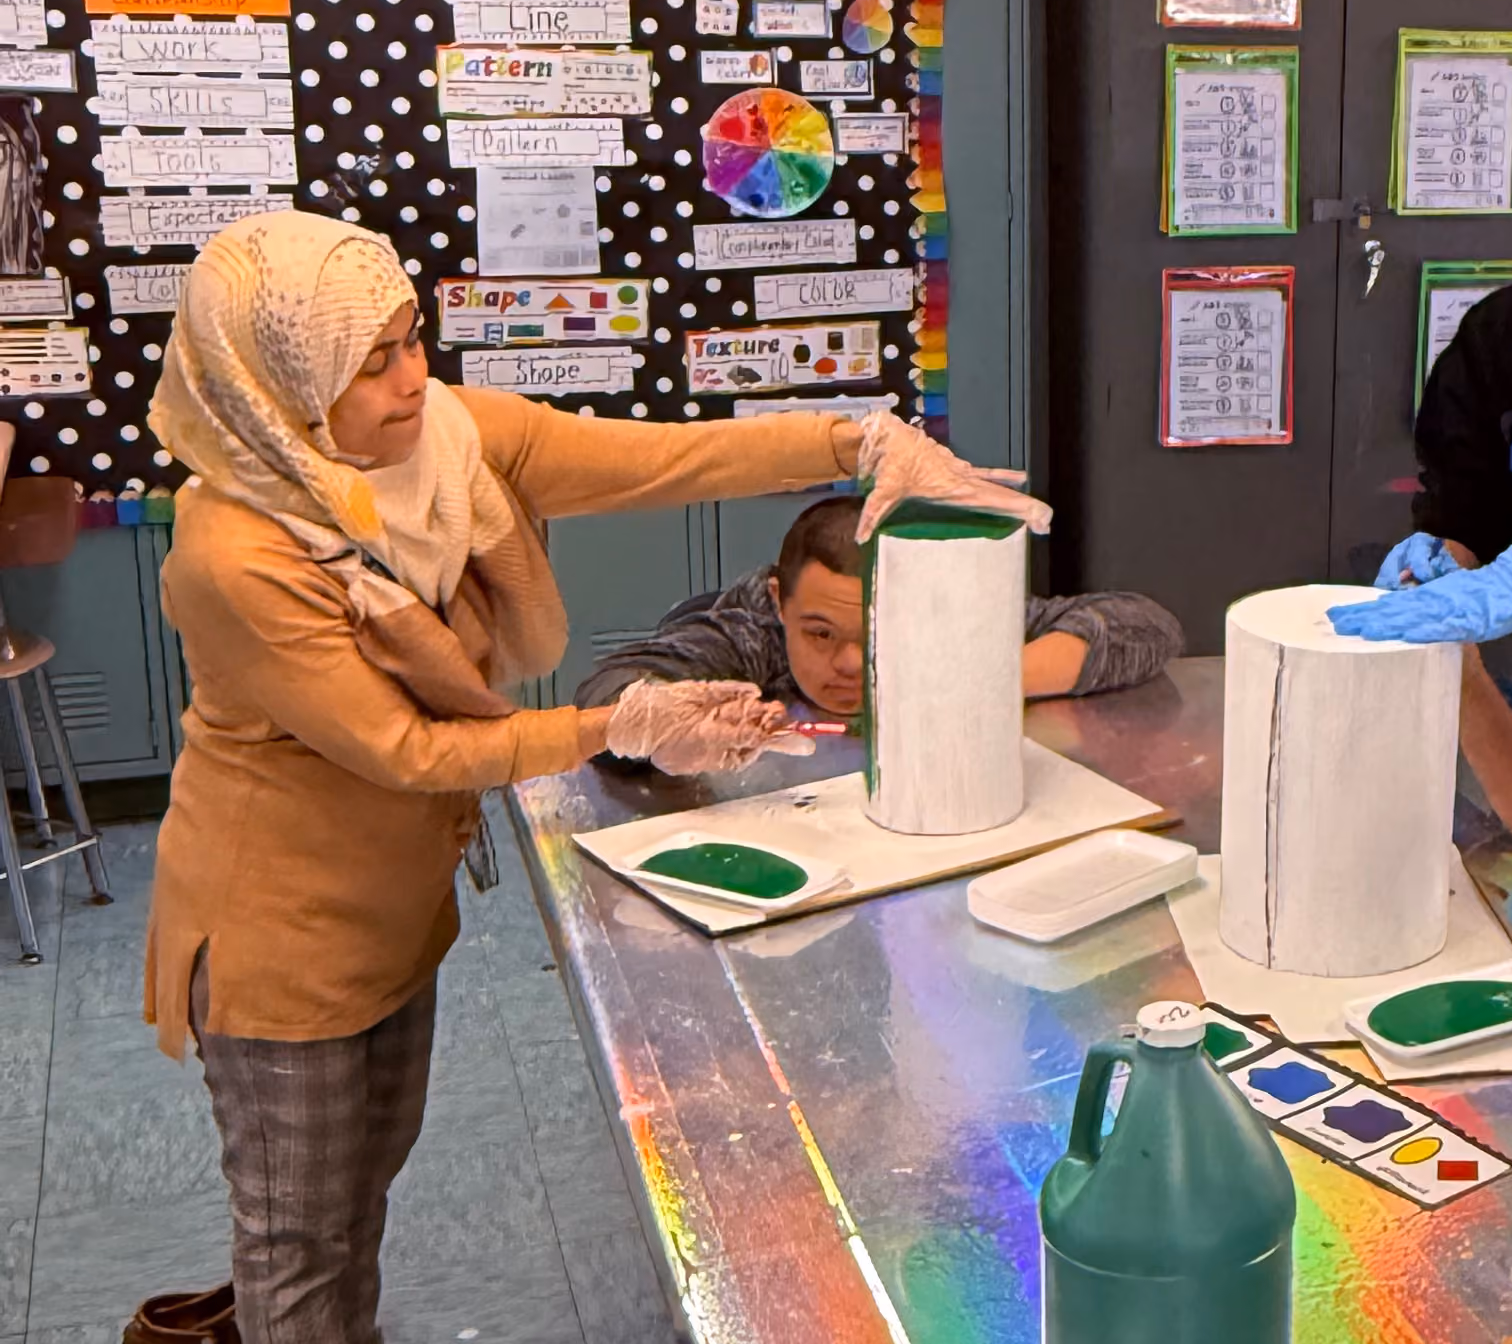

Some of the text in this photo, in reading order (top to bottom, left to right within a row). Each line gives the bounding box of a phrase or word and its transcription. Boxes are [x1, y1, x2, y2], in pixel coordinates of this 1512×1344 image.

[508, 5, 571, 33] Line
[446, 52, 553, 78] Pattern
[447, 285, 532, 316] Shape
[692, 337, 780, 358] Texture
[515, 360, 581, 386] Shape
